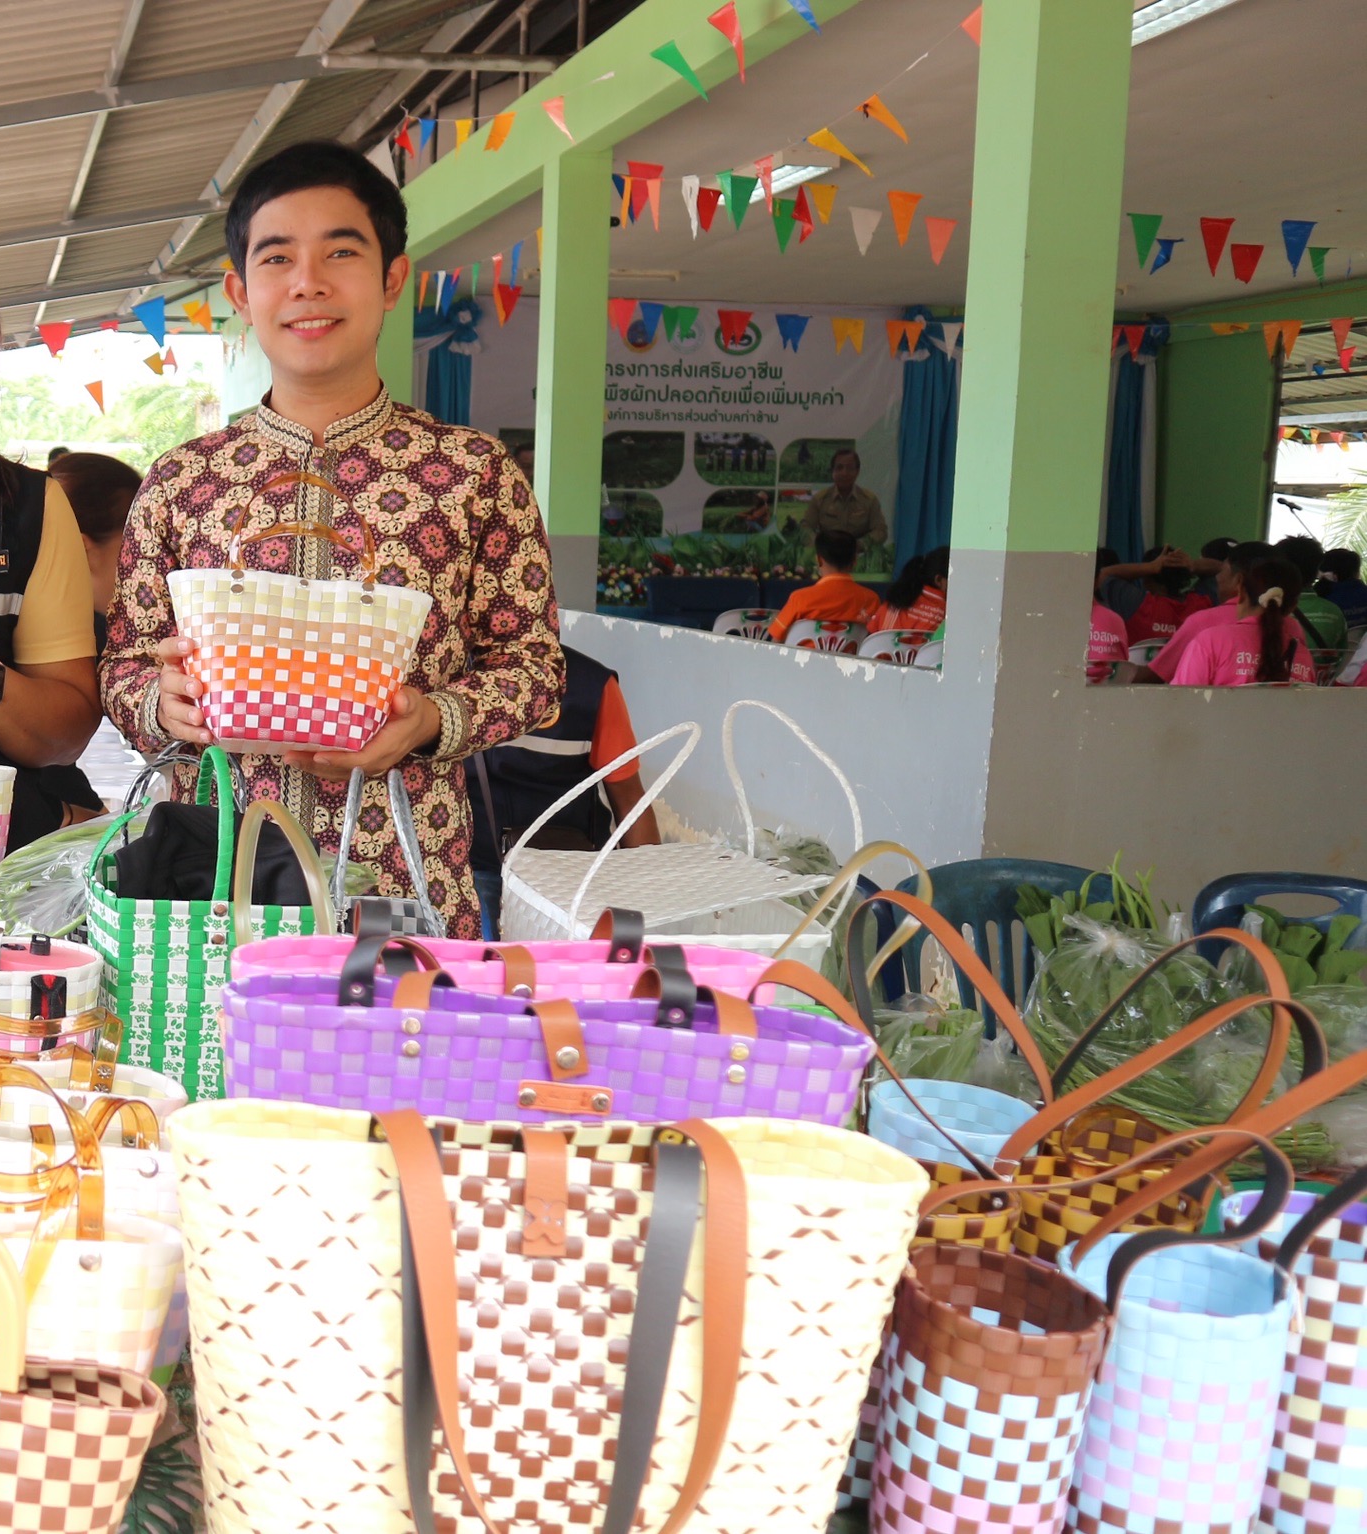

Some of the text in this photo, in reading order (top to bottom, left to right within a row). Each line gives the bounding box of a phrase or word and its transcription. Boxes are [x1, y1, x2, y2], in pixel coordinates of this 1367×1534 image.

[605, 358, 783, 380] ครงการส่งเสริมอาชีพ
[607, 407, 779, 423] งค์การบริหารส่วนตำบลท่าข้าม
